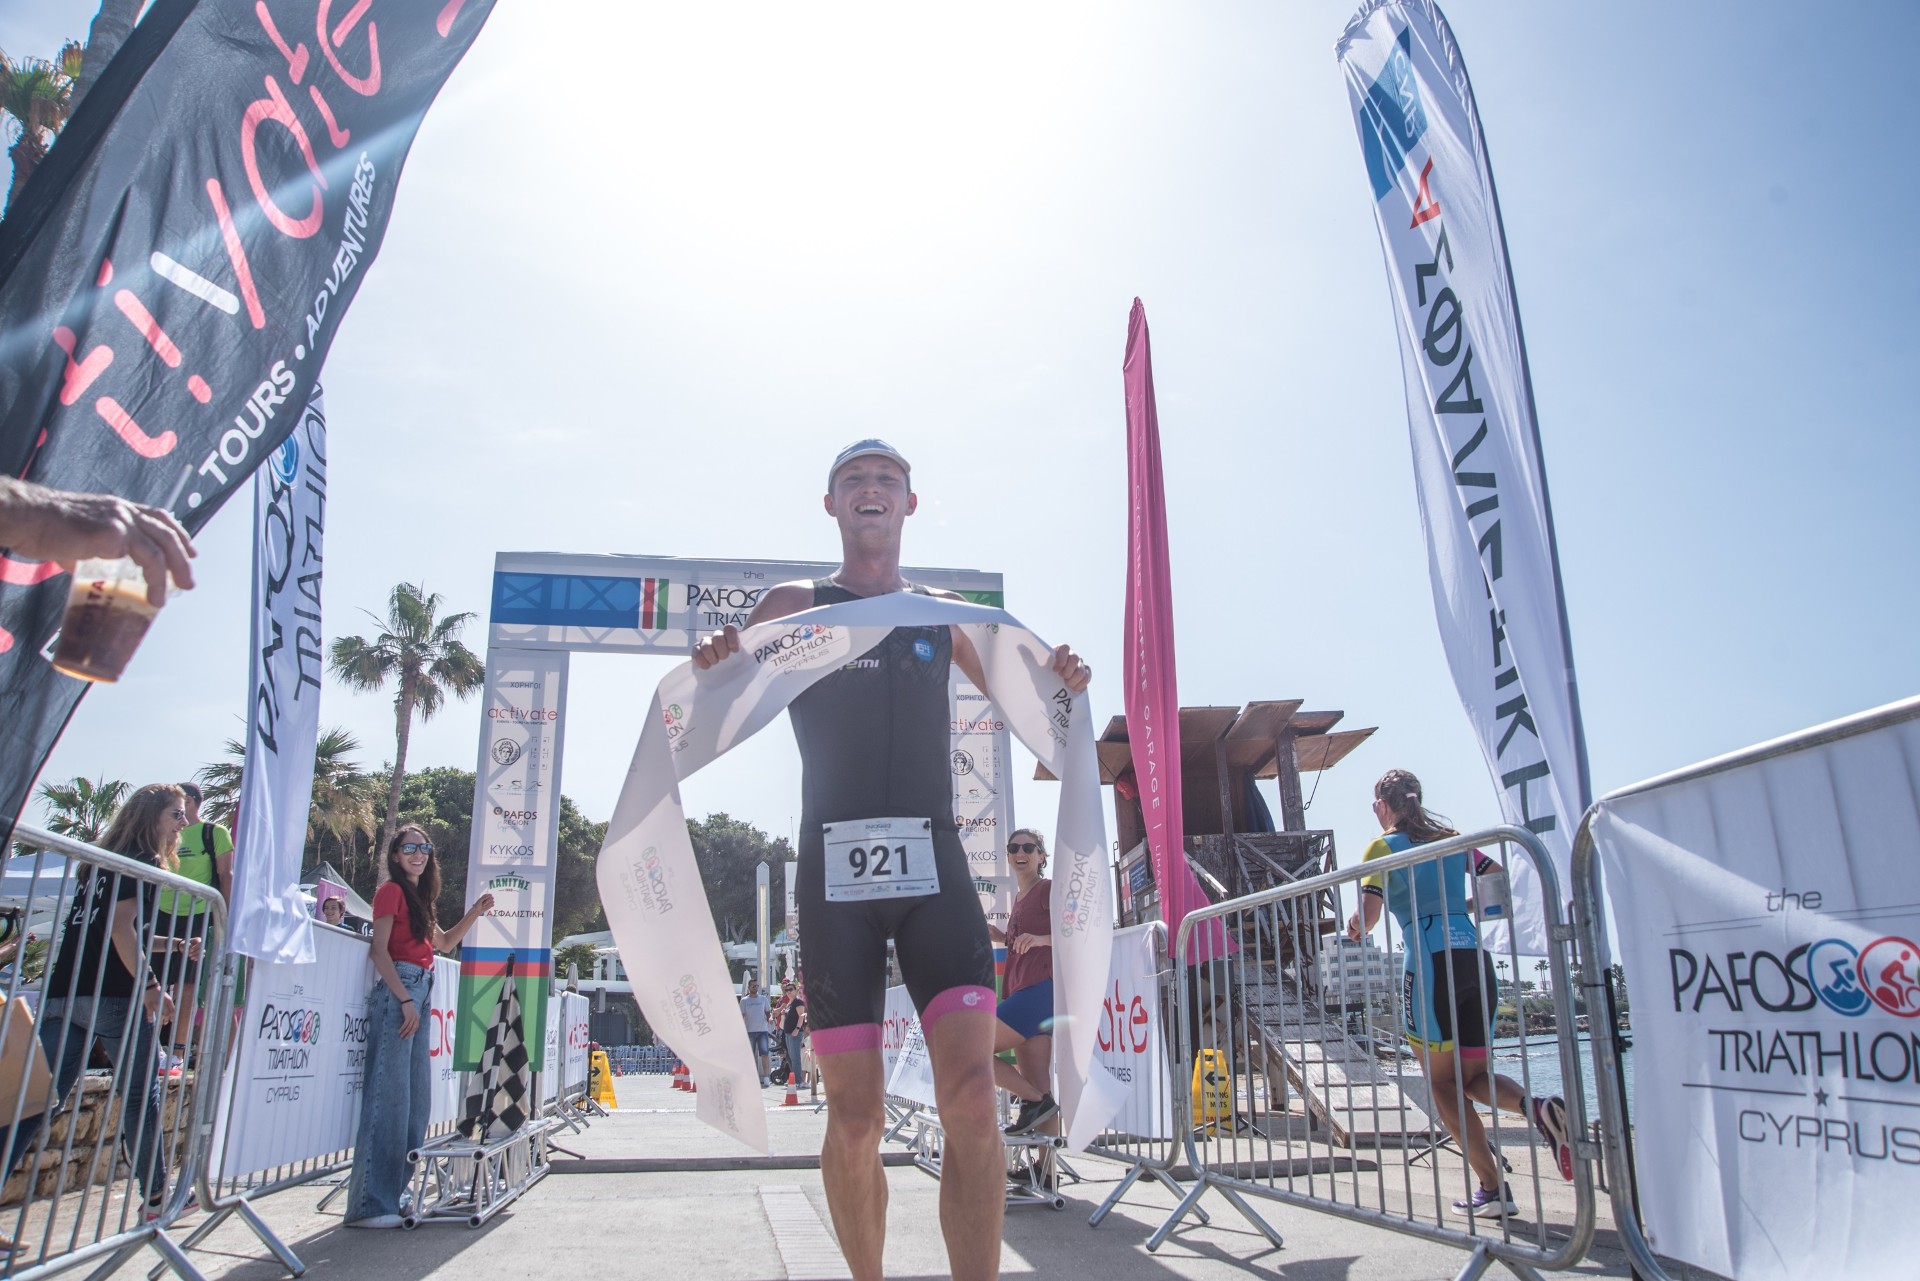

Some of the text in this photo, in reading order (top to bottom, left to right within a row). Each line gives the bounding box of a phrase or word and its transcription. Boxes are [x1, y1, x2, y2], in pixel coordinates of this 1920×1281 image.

[198, 151, 376, 486] TOURS ADVENTURES
[743, 571, 765, 580] the
[686, 584, 761, 608] PAFOS
[704, 611, 750, 627] TRIAT
[753, 627, 802, 664] PAFOS
[770, 631, 834, 667] TRIATHLON
[783, 648, 830, 676] CYPRUS
[510, 681, 541, 689] ΧΟΡΗΓΟΙ
[487, 706, 558, 721] activate
[1137, 599, 1148, 693] COFFEE
[1143, 704, 1160, 809] GARAGE
[950, 718, 1004, 731] ctivate
[503, 810, 538, 820] PAFOS
[965, 818, 997, 827] PAFOS
[848, 844, 908, 878] 921
[489, 878, 531, 890] ΛΑΝΙΤΗΣ
[975, 882, 998, 894] ΙΤΗΣ
[1765, 887, 1823, 912] the
[1668, 942, 1818, 1013] PAFOS
[266, 1085, 300, 1104] CYPRUS
[1739, 1109, 1920, 1165] CYPRUS
